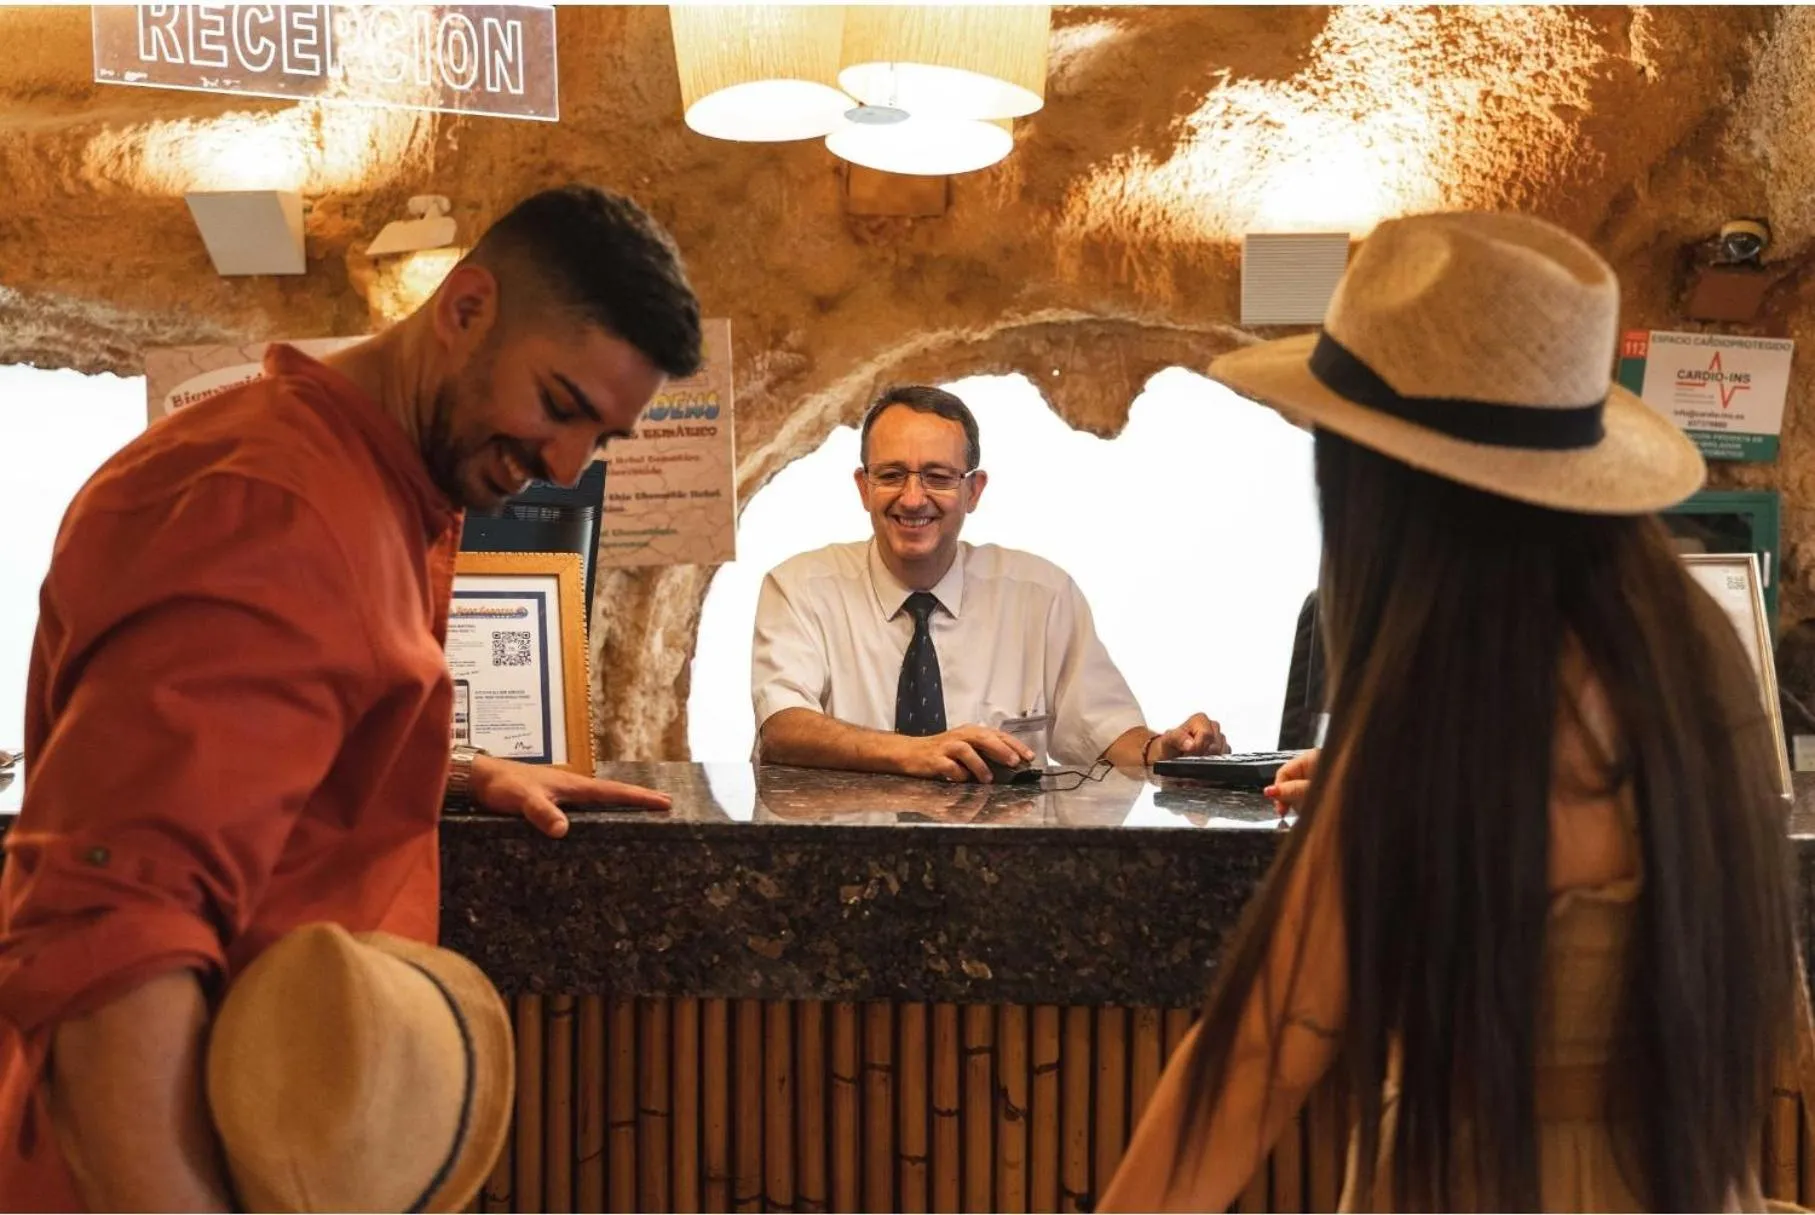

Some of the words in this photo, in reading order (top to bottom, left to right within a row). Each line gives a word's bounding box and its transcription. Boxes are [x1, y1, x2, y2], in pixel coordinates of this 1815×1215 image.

[1624, 341, 1646, 355] 112
[1652, 334, 1691, 345] ESPACIO
[1693, 337, 1792, 351] CARDIOPROTEGIDO
[1677, 369, 1750, 383] CARDIO-INS
